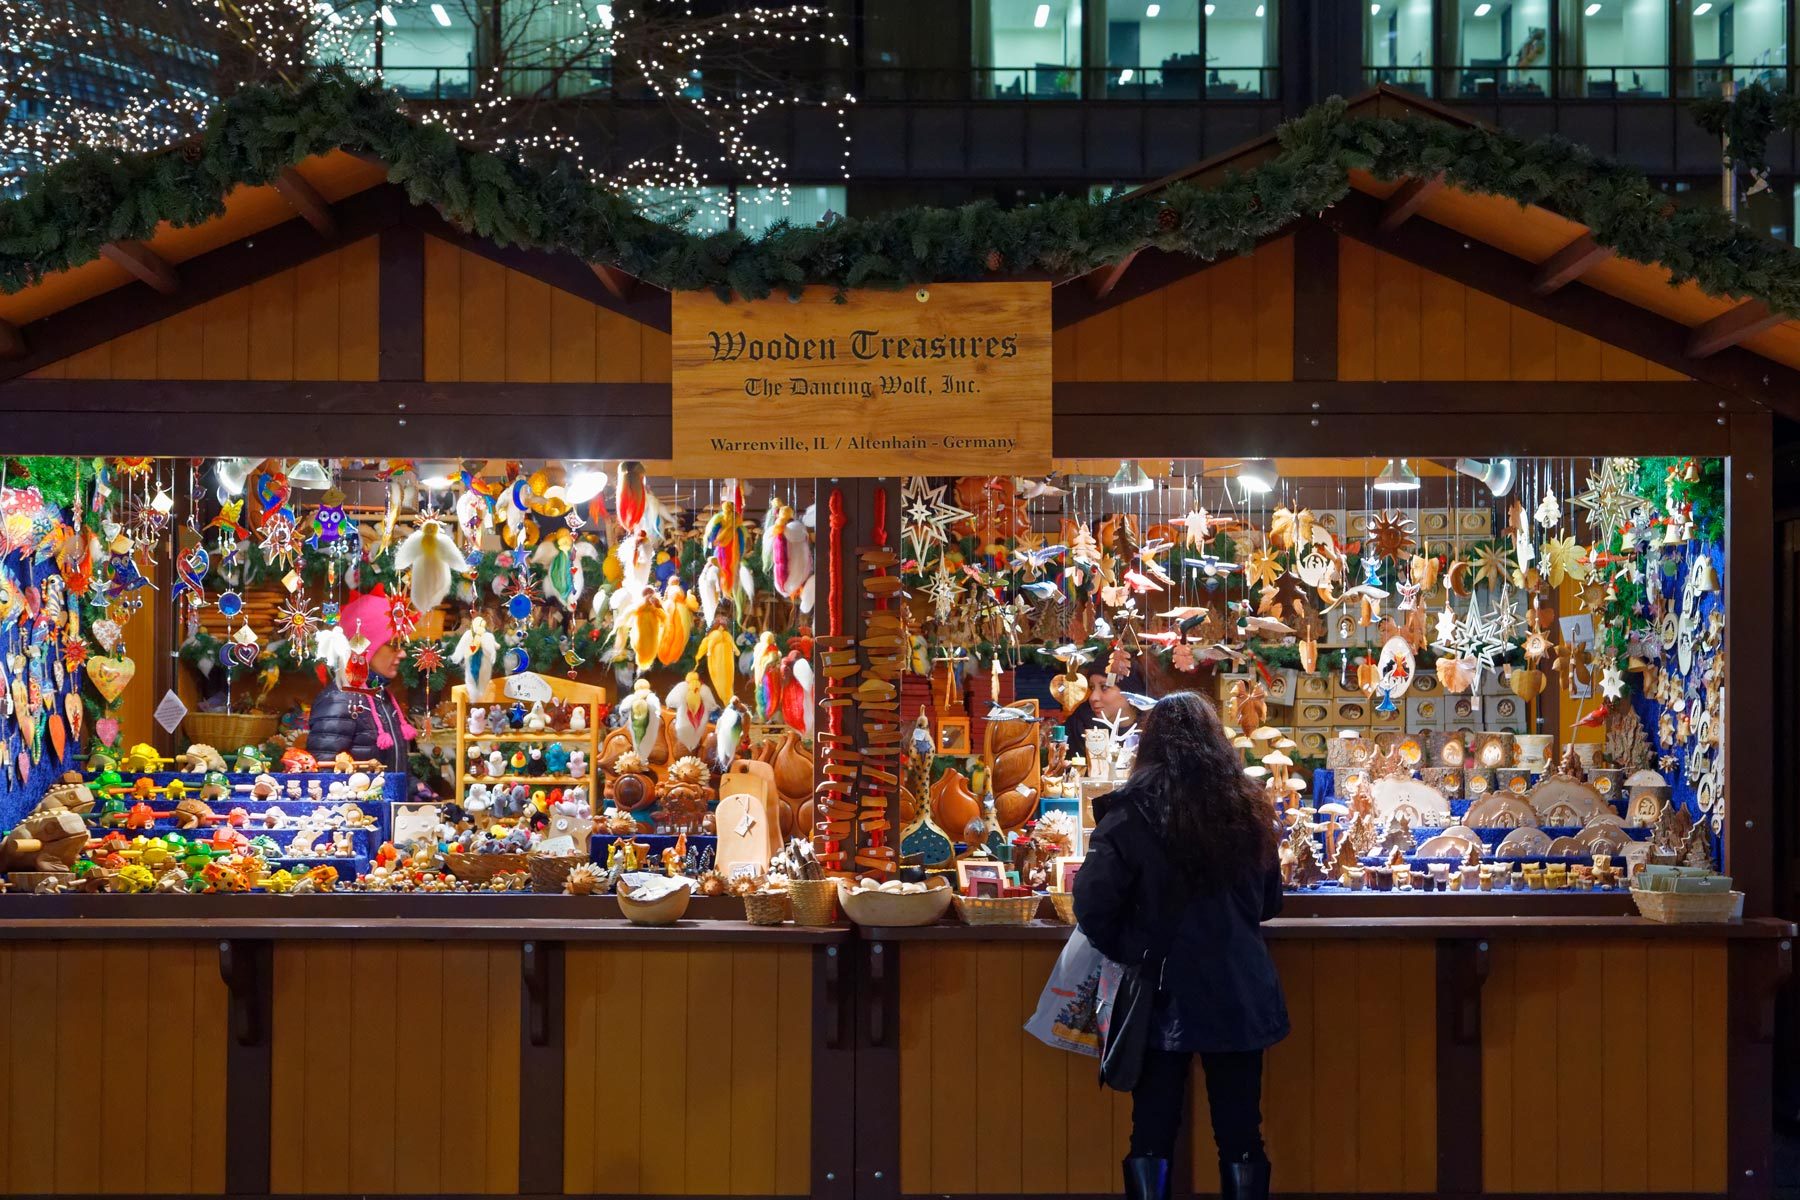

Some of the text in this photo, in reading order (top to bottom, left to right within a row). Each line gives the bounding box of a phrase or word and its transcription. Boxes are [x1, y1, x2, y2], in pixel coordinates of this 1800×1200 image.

[707, 329, 1018, 362] Wooden Treasures
[744, 374, 981, 399] The Dancing Wolf, Inc.
[710, 436, 809, 453] Warrenville,
[813, 436, 830, 451] IL
[847, 435, 927, 450] Altenhain
[942, 434, 1017, 453] Germany
